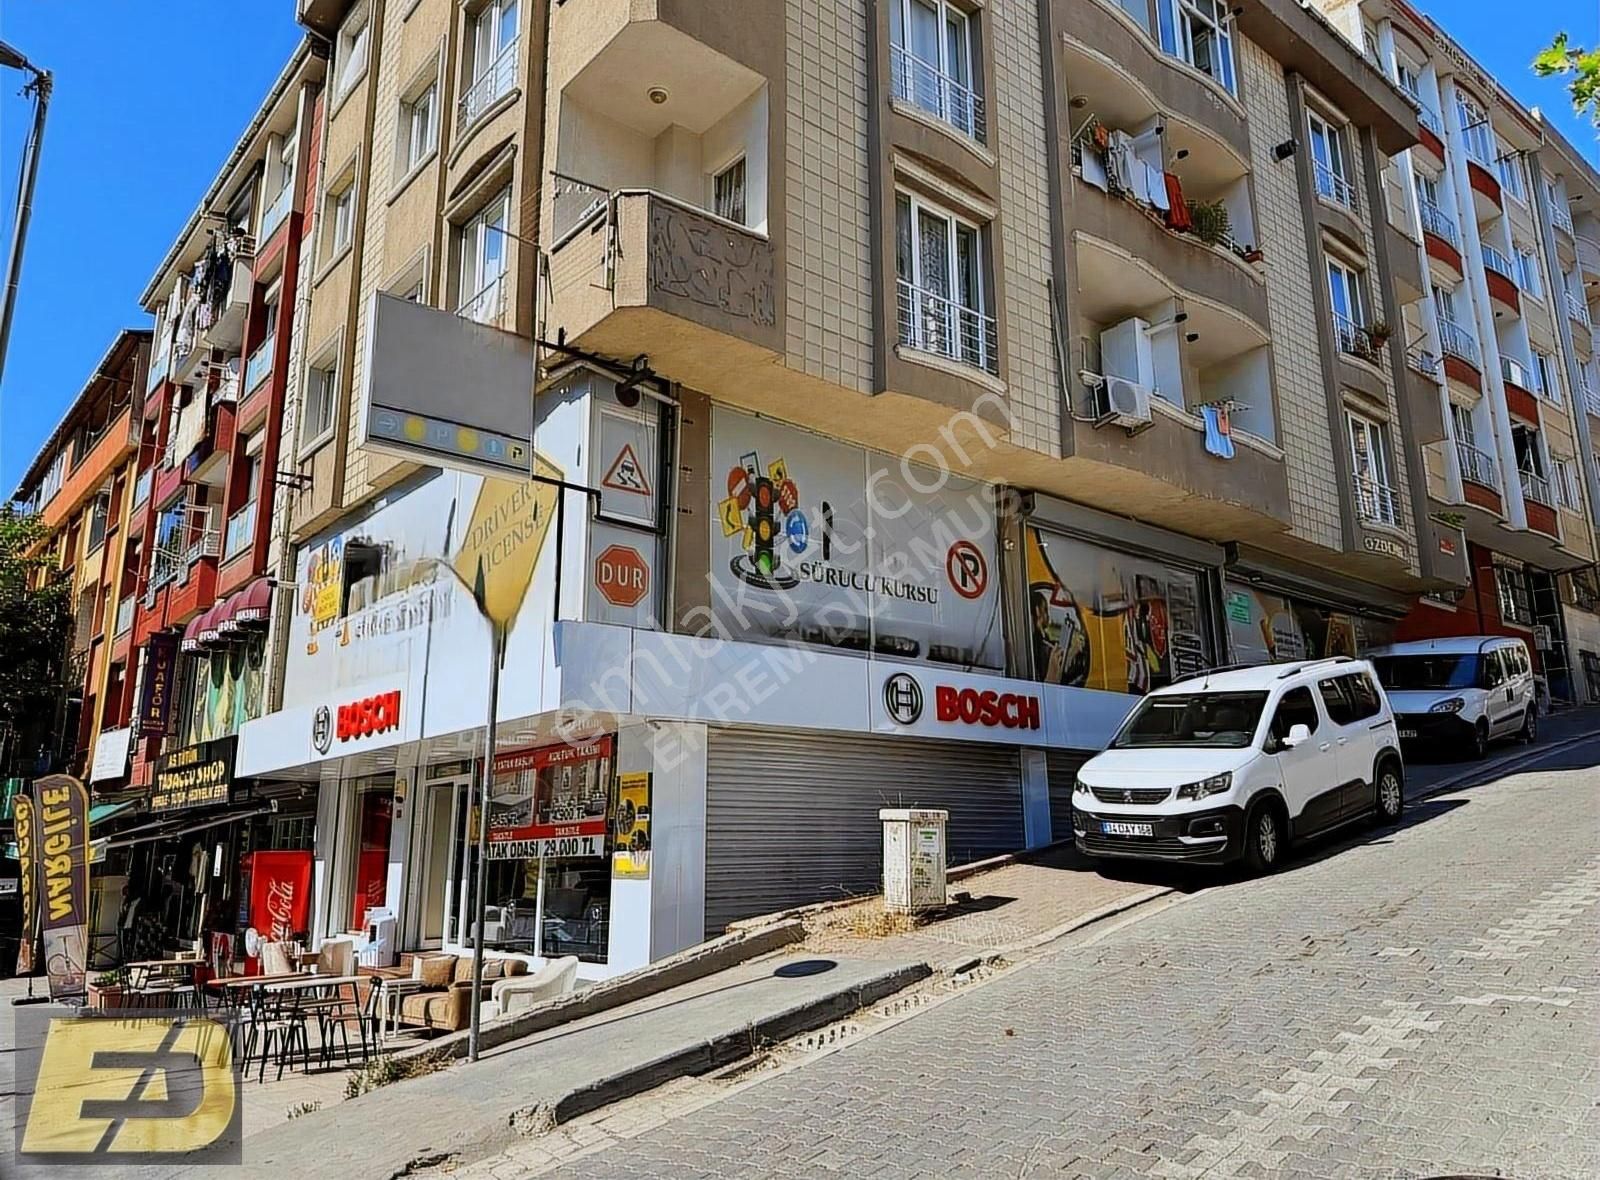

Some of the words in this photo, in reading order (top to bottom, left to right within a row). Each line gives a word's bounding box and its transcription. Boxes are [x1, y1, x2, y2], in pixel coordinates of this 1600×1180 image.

[601, 561, 643, 589] DUR
[881, 575, 938, 605] KURSU
[337, 690, 401, 743] BOSCH
[935, 685, 1041, 731] BOSCH
[196, 759, 225, 785] SHOP
[510, 840, 538, 858] ODASI
[543, 838, 579, 857] 29.000
[581, 837, 596, 855] TL
